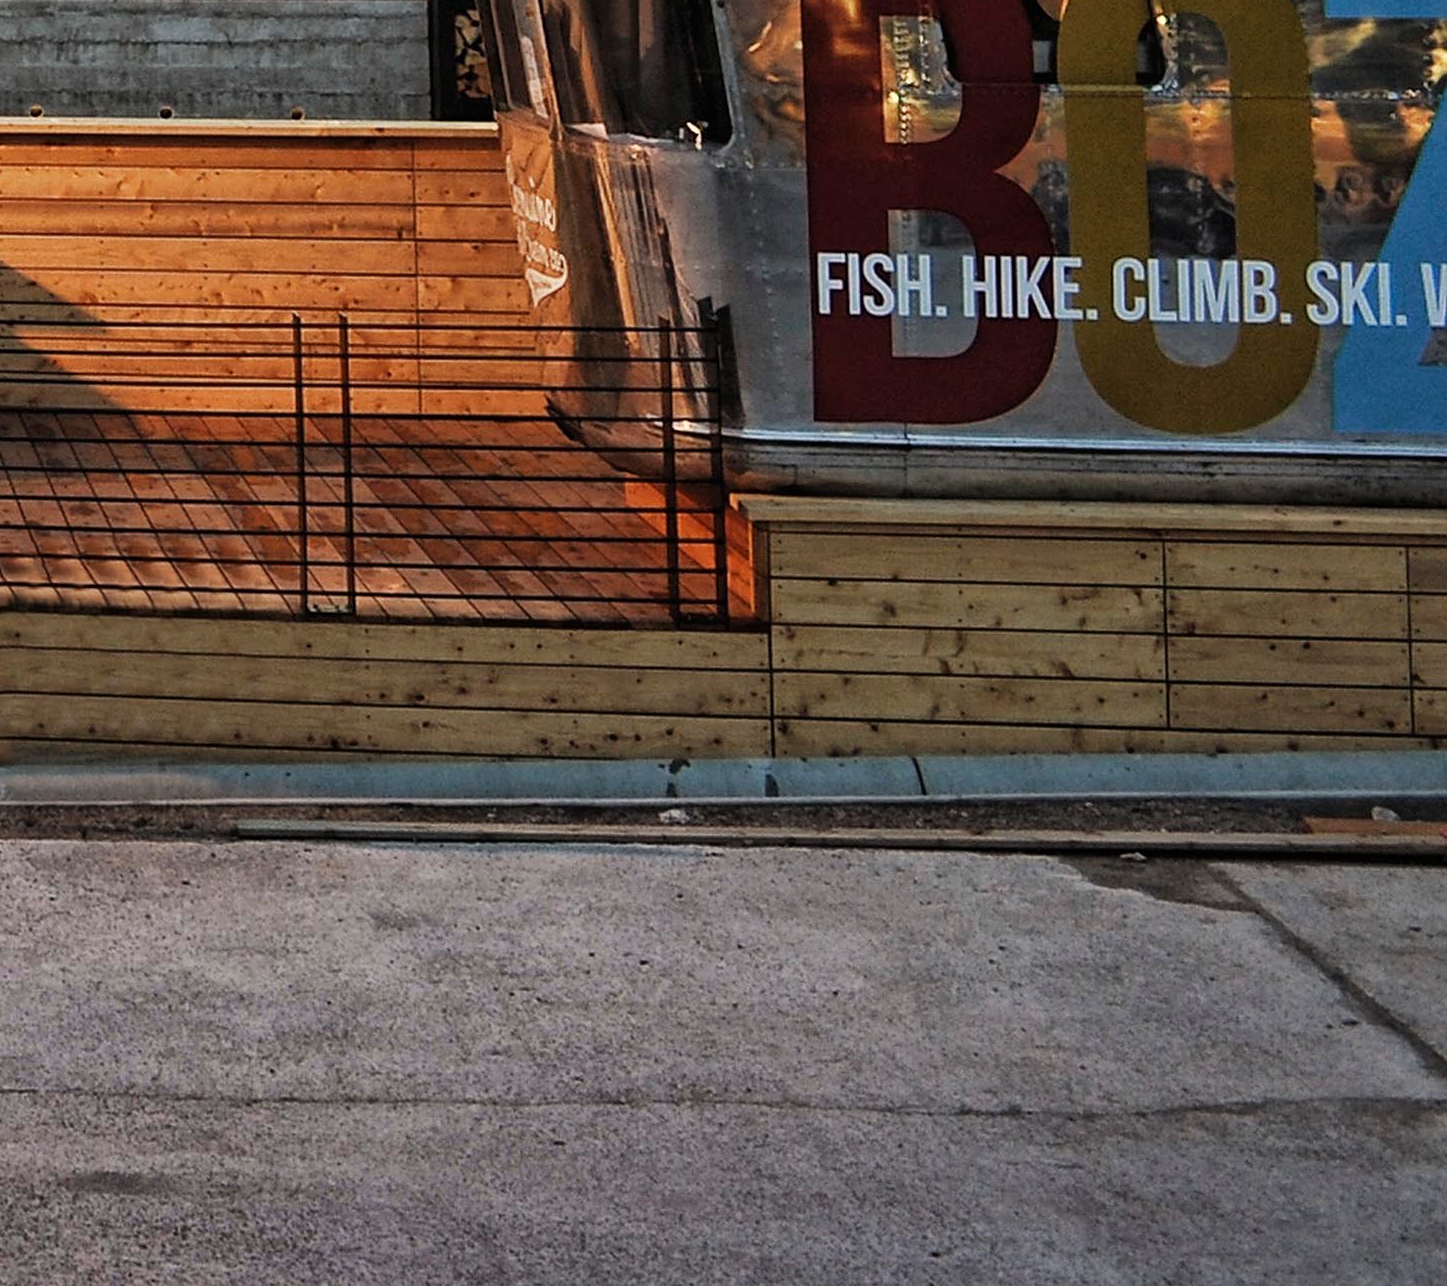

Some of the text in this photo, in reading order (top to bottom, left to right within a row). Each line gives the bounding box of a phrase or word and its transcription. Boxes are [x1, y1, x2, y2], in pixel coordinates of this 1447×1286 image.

[817, 251, 949, 318] FISH.
[963, 254, 1099, 321] HIKE.
[1112, 257, 1293, 325] CLIMB.
[1305, 260, 1408, 327] SKI.
